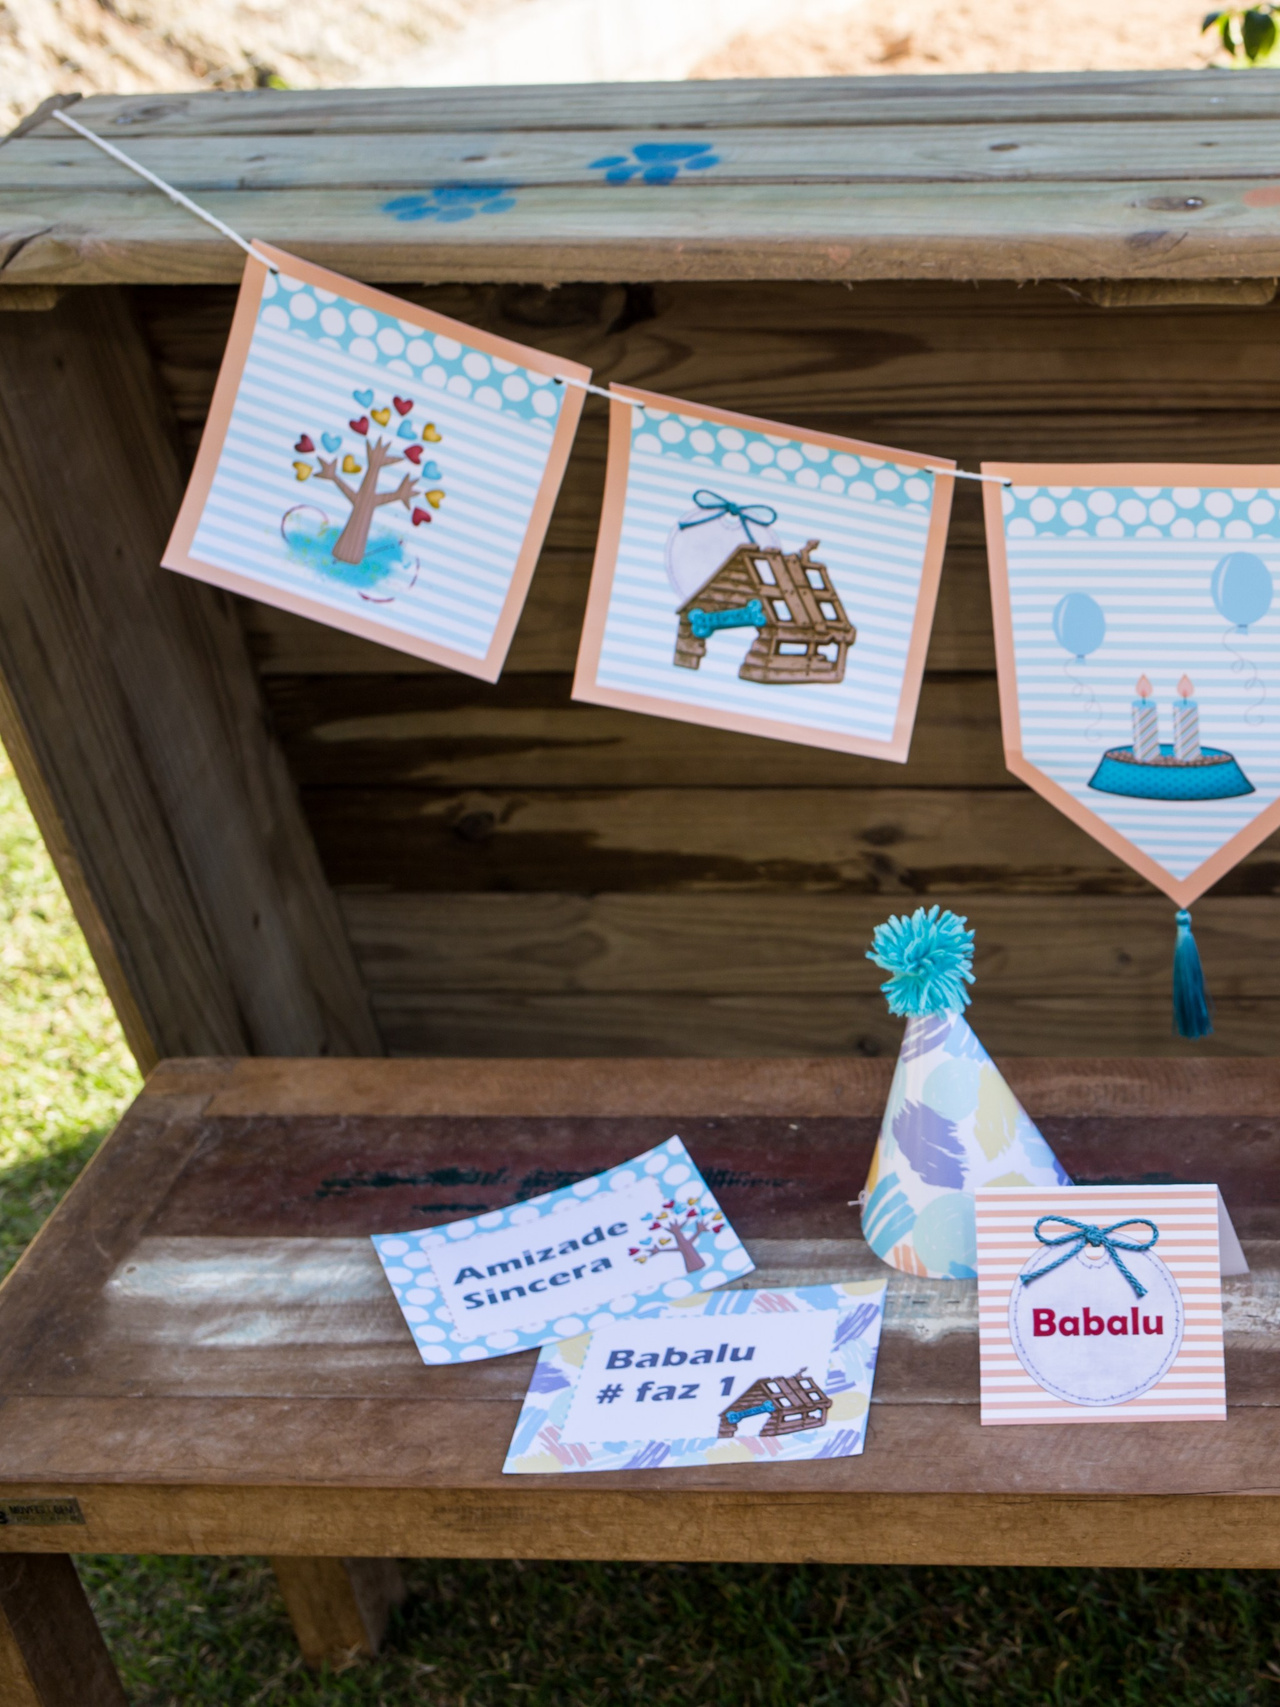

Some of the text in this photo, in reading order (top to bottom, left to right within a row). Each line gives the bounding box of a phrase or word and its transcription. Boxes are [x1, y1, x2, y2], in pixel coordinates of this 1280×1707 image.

[453, 1220, 629, 1286] Amizade
[462, 1256, 614, 1310] Sincera
[1032, 1306, 1164, 1337] Babalu
[605, 1343, 756, 1370] Babalu
[596, 1376, 736, 1404] # faz 1
